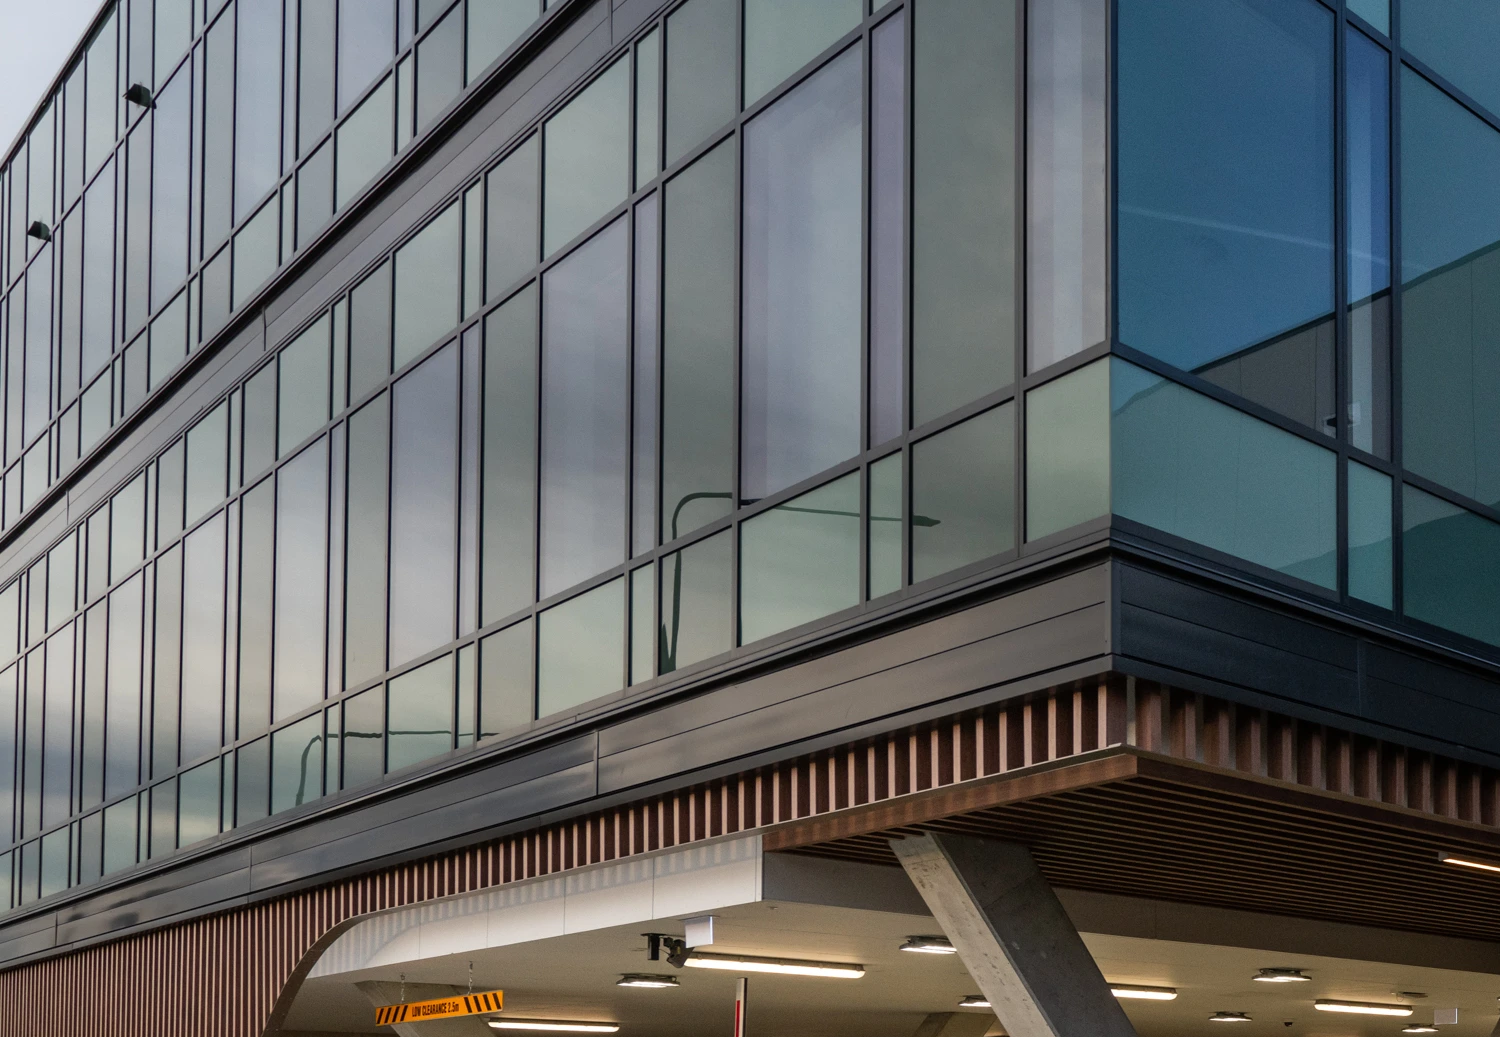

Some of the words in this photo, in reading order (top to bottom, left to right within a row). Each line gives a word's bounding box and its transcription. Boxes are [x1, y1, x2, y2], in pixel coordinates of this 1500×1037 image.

[412, 1005, 421, 1017] LOW
[422, 1003, 447, 1016] CLEARANCE
[447, 1001, 459, 1013] 2.5m
